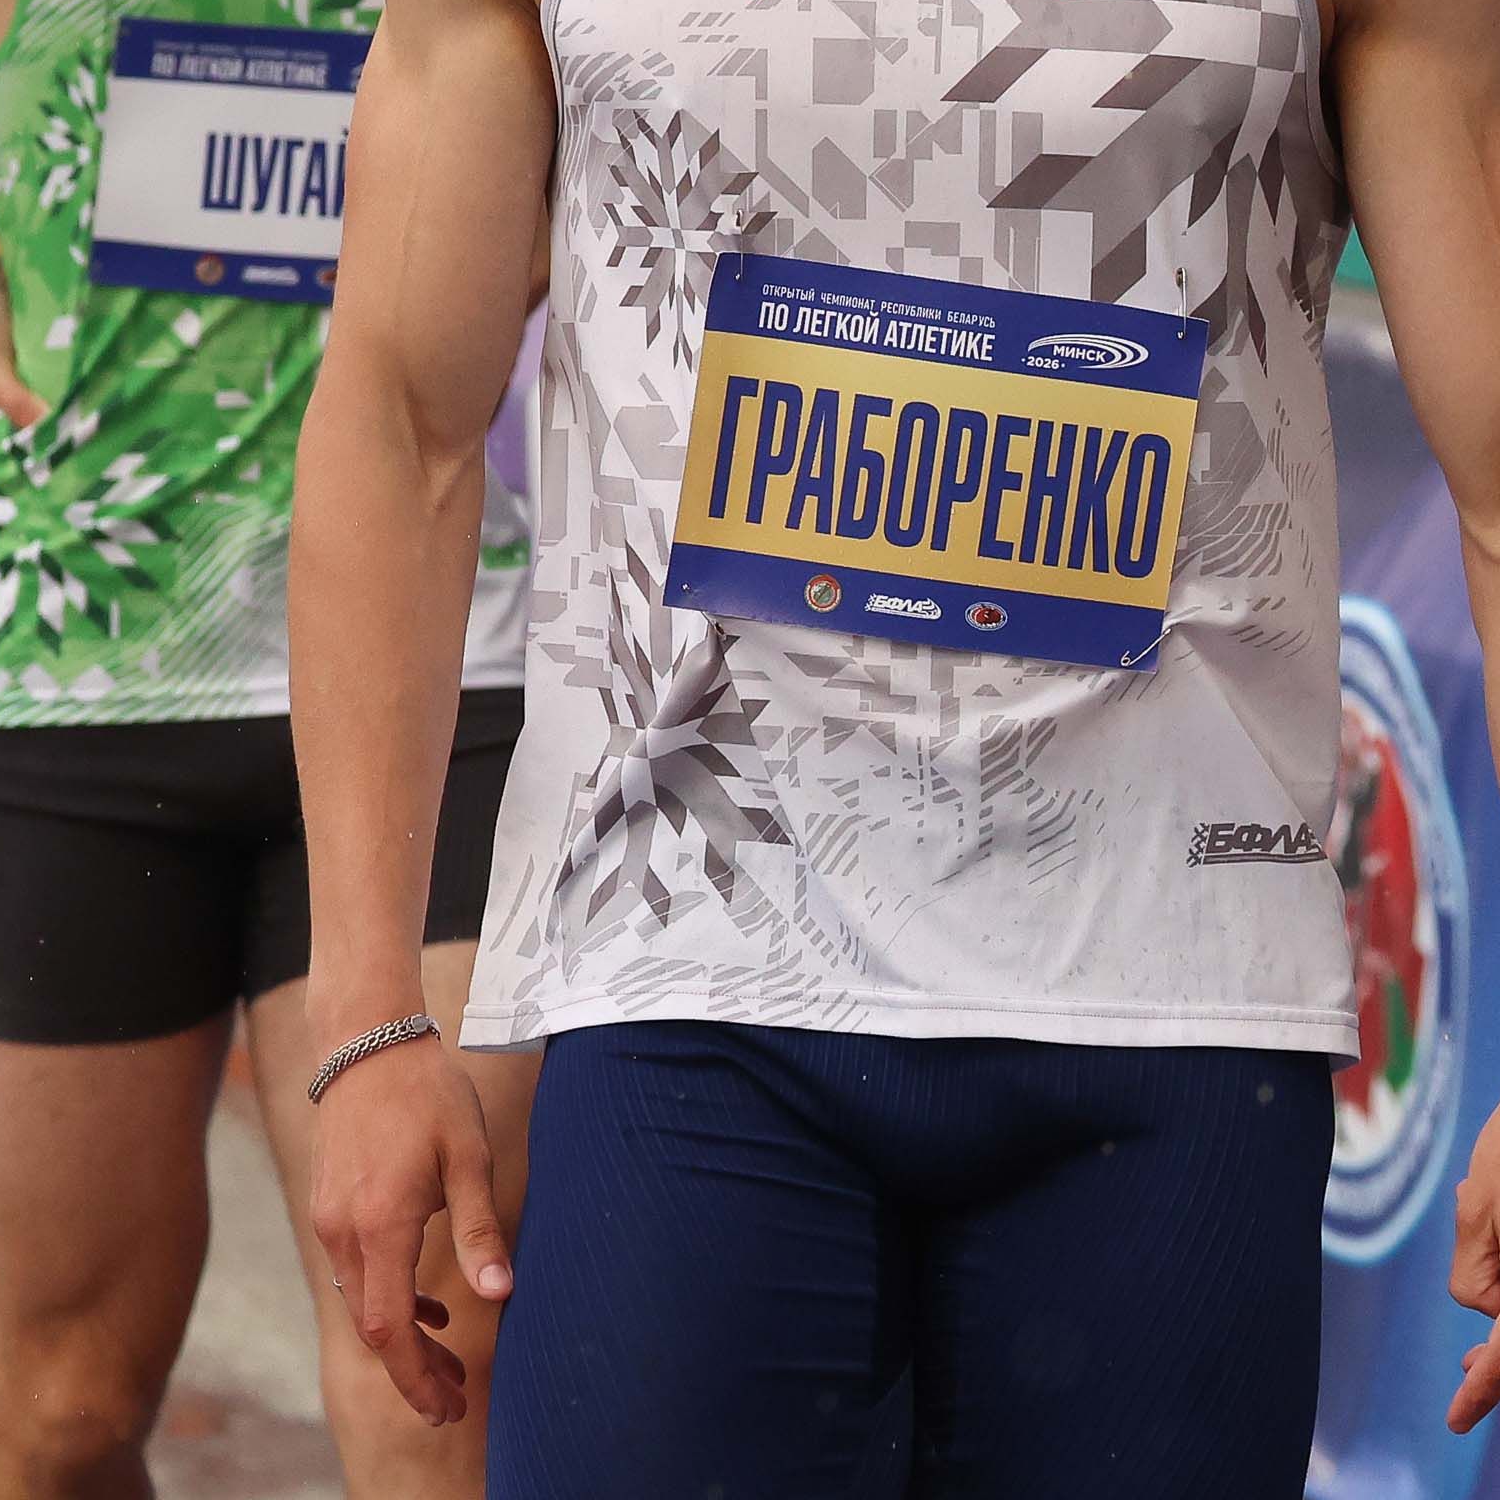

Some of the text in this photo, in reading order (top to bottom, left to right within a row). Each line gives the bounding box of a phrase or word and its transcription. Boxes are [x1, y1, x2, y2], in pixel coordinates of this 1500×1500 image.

[758, 301, 996, 362] ПО ЛЕГКОЙ АТЛЕТИКЕ
[762, 283, 996, 329] ОТКРЫТЫЙ ЧЕМПИОНАТ РЕСПУБЛИКИ БЕЛАРУСЬ
[1052, 344, 1106, 363] МИНСК
[707, 374, 1173, 580] ГРАБОРЕНКО
